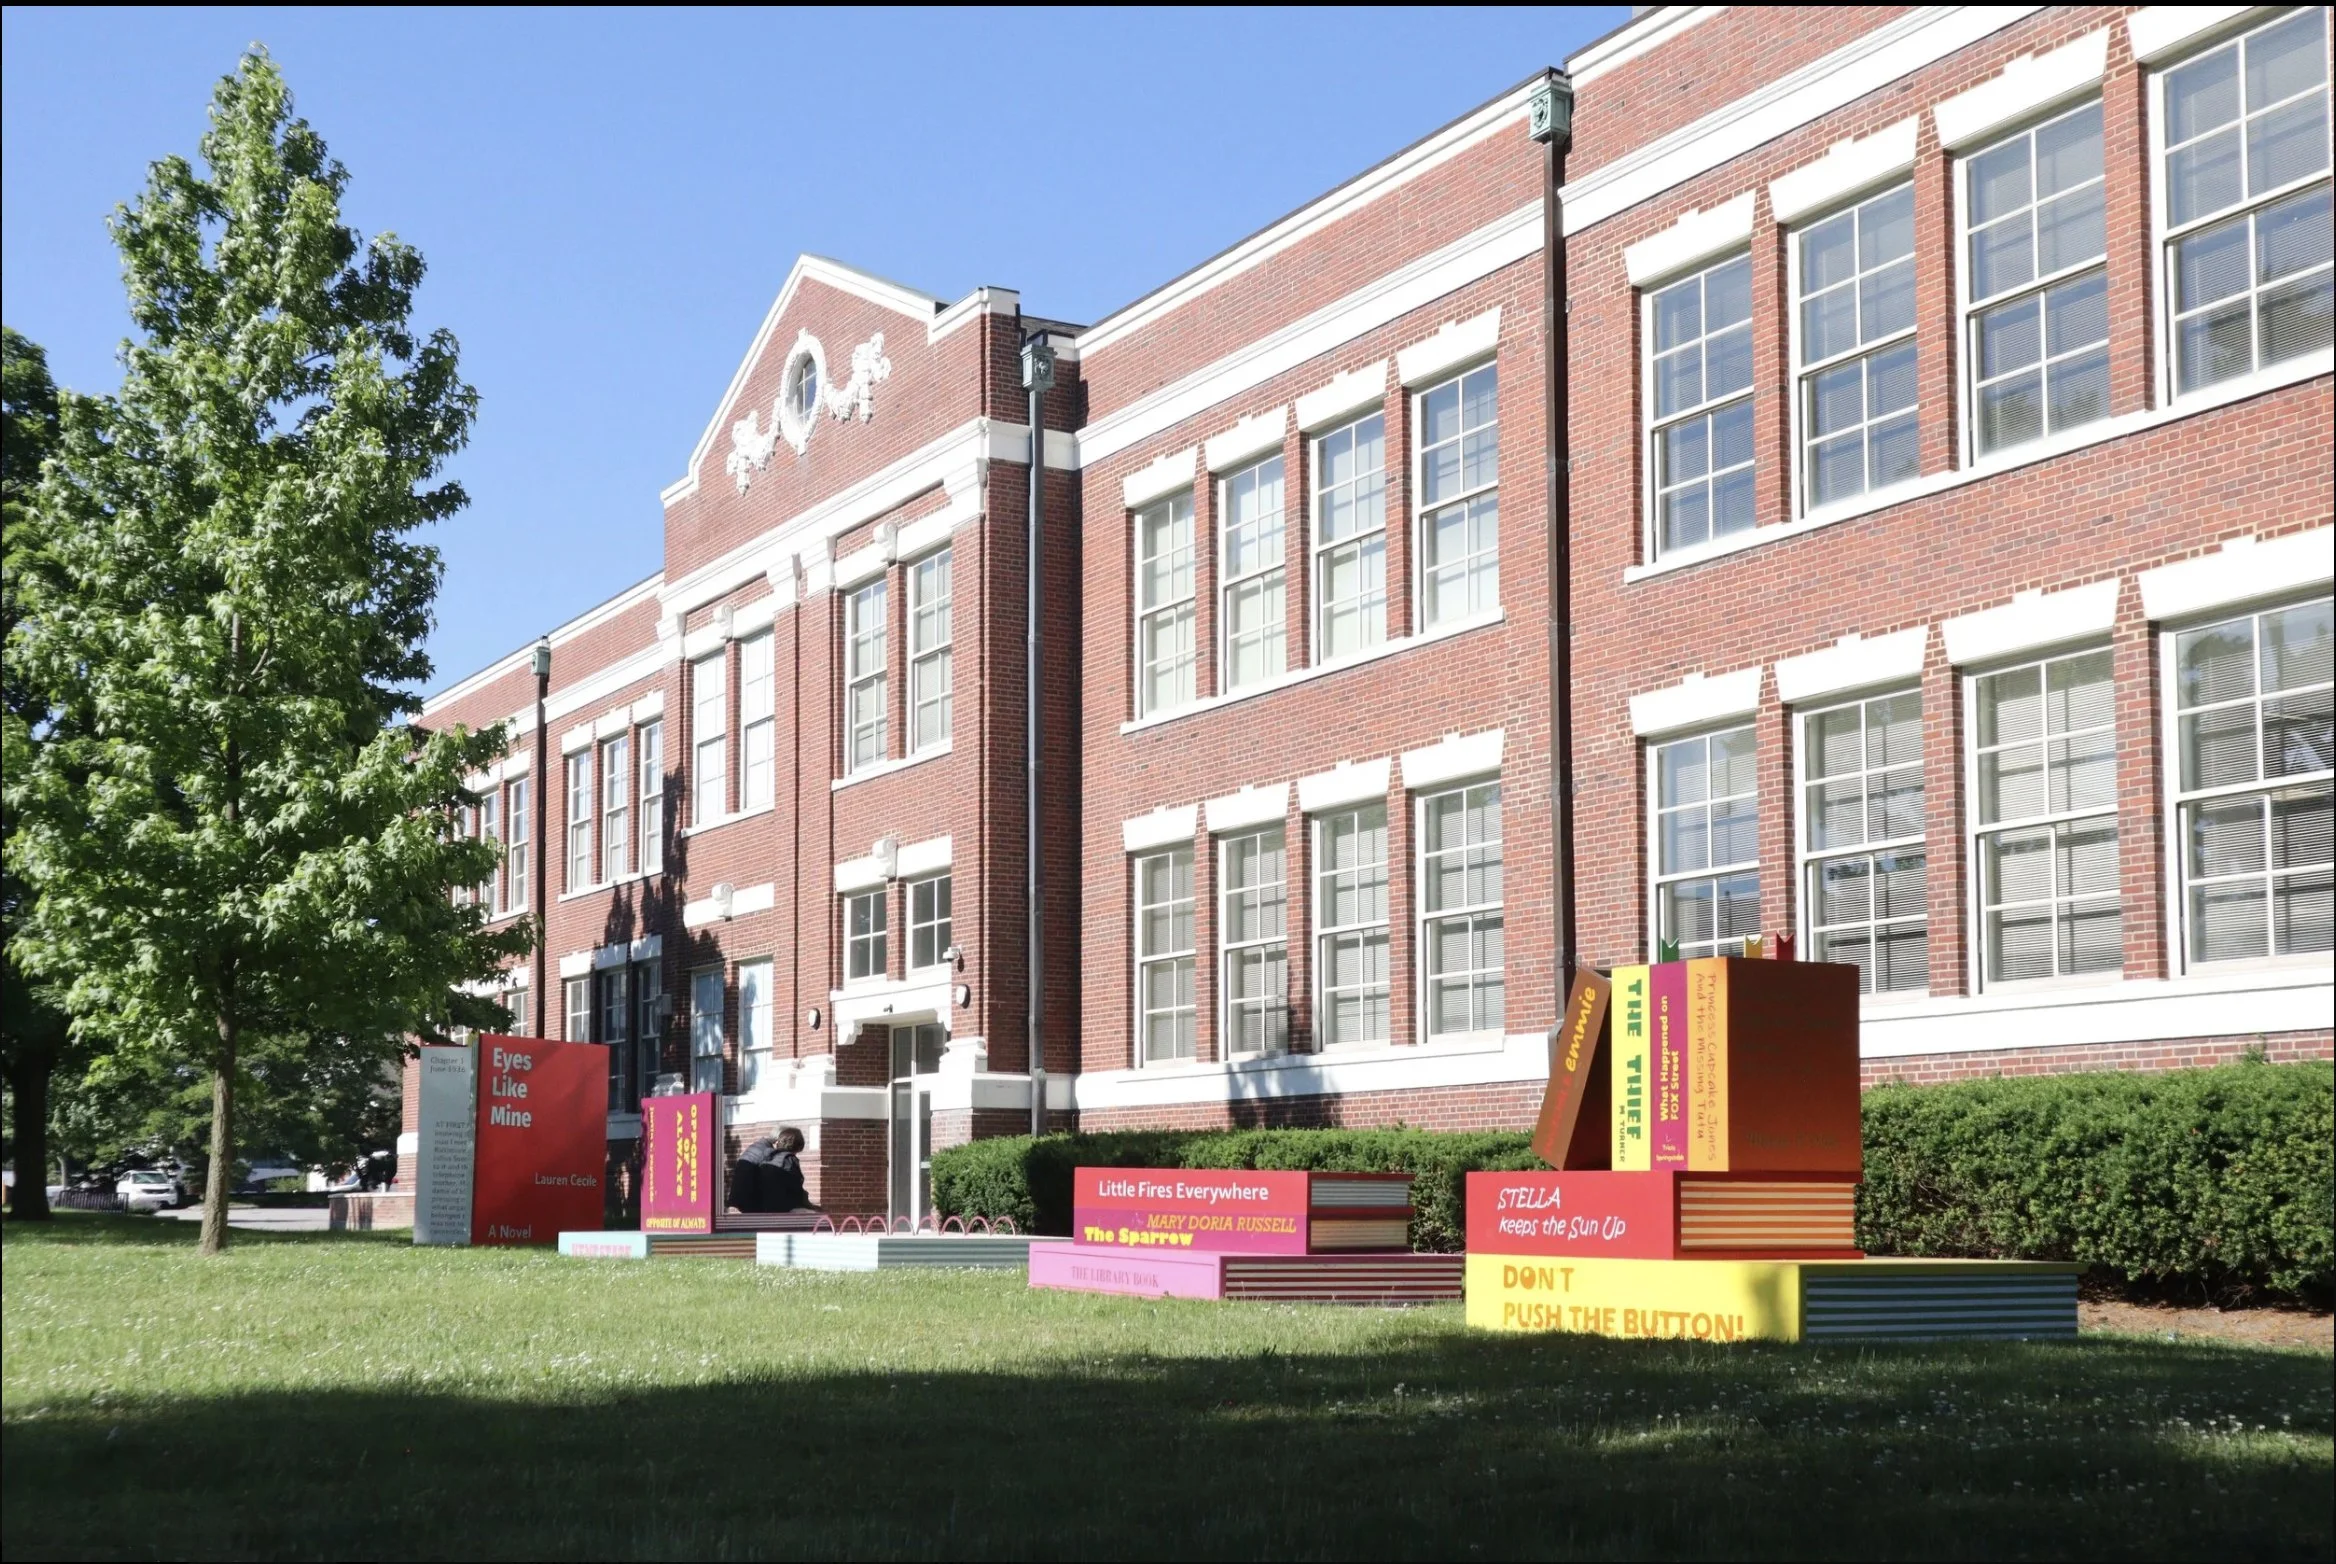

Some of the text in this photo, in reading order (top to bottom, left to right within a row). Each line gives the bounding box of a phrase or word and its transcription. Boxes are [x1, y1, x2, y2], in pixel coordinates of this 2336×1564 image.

[1707, 973, 1717, 1039] Princess
[1565, 986, 1596, 1072] emmie
[493, 1047, 532, 1074] Eyes
[1626, 979, 1642, 1140] THE THIEF
[1660, 995, 1670, 1121] What Happened on
[1694, 973, 1706, 1138] And the Missing Tutu
[492, 1075, 528, 1098] Like
[1671, 1050, 1679, 1120] FOX Street
[1707, 1042, 1718, 1108] Cupcake
[490, 1104, 532, 1127] Mine
[684, 1138, 690, 1165] OF
[535, 1172, 597, 1187] Lauren Cecile
[1099, 1180, 1269, 1204] Little Fires Everywhere
[1497, 1186, 1561, 1210] STELLA
[488, 1224, 532, 1238] A Novel
[646, 1217, 706, 1229] OPPOSITE OF ALWAYS
[1084, 1226, 1194, 1246] The Sparrow
[1147, 1214, 1296, 1233] MARY DORIA RUSSELL
[1499, 1215, 1626, 1241] keeps the Sun Up
[1071, 1266, 1159, 1288] THE LIBRARY BOOK
[1503, 1302, 1744, 1341] PUSH THE BUTTON!
